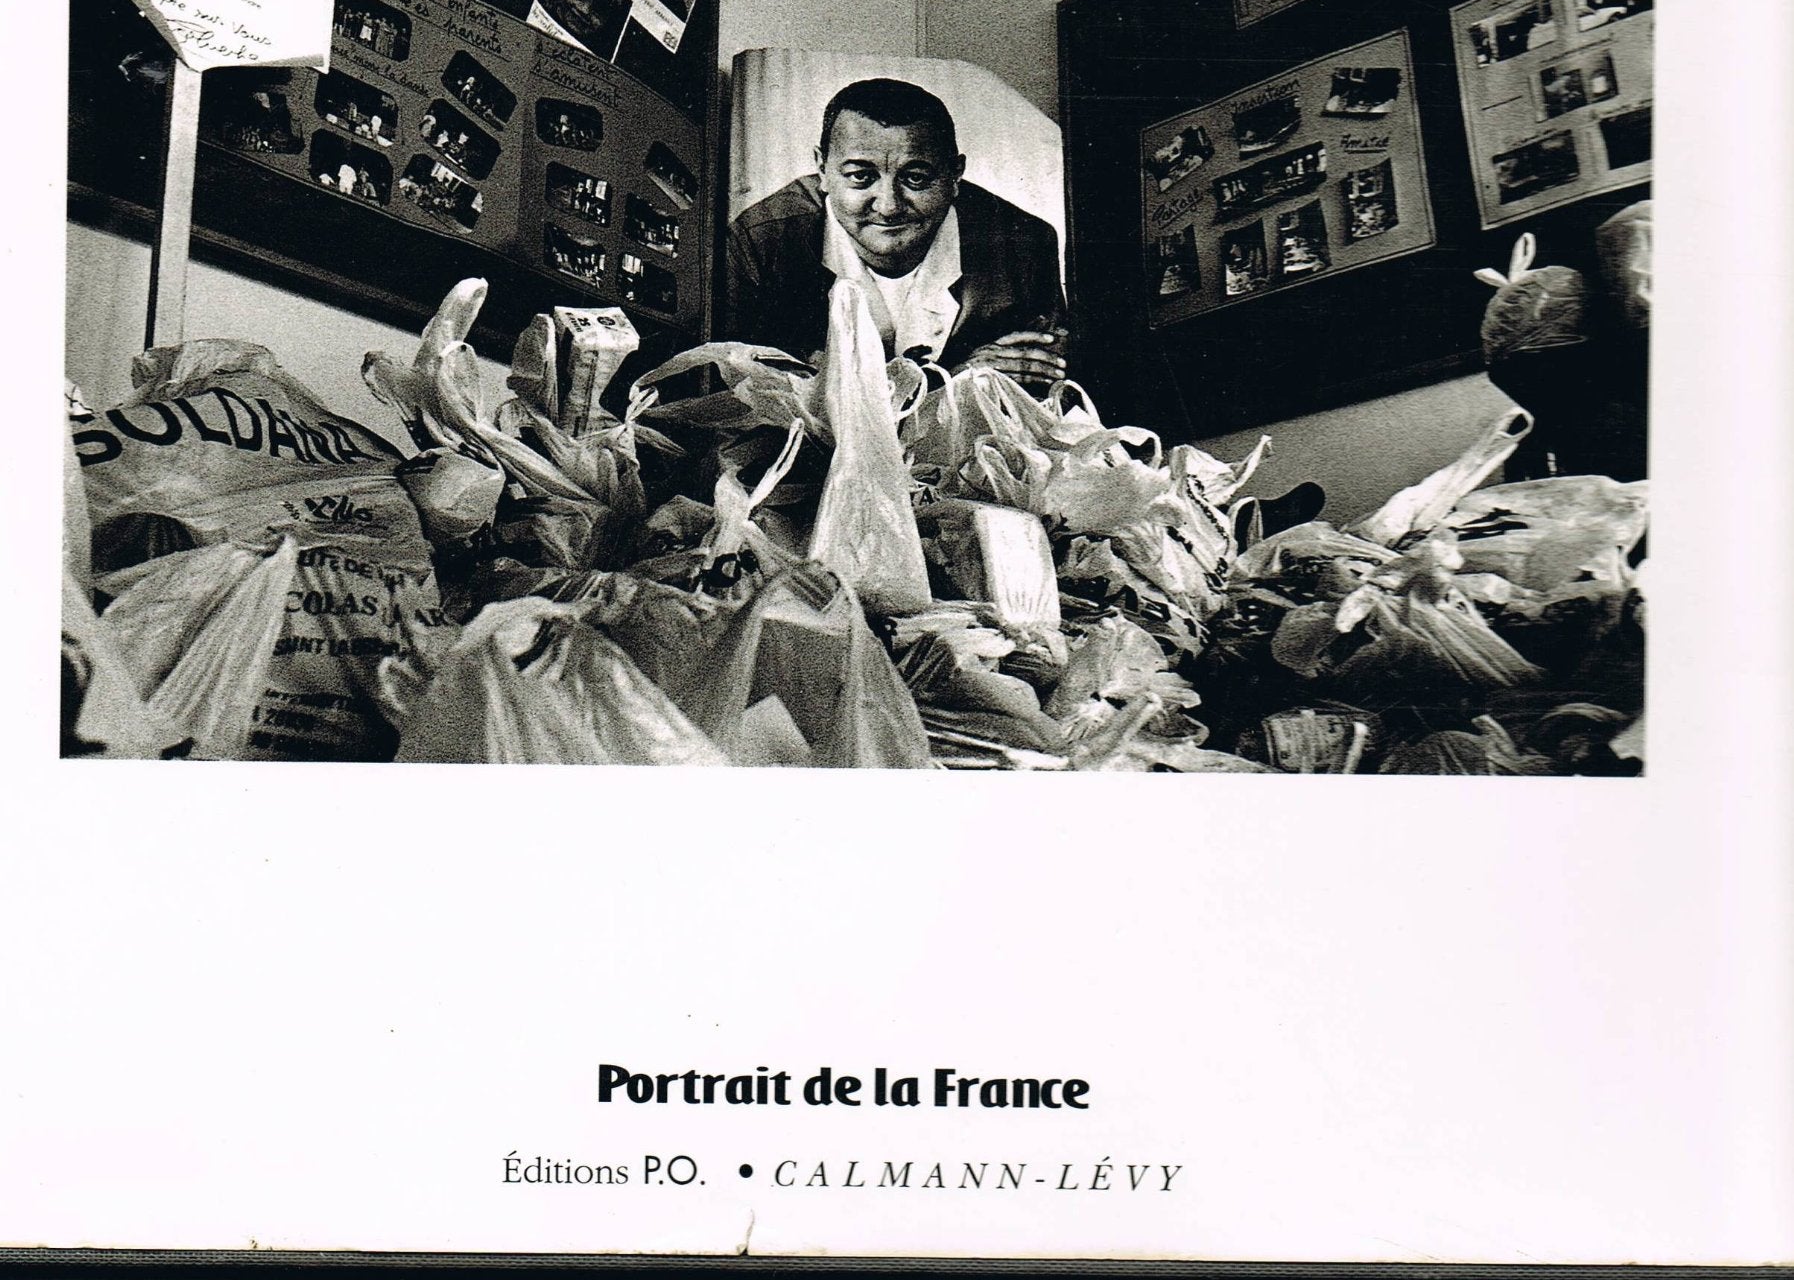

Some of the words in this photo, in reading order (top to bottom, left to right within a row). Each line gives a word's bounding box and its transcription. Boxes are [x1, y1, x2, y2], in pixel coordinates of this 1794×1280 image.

[599, 1064, 791, 1105] Portrait
[804, 1067, 861, 1106] de
[875, 1068, 920, 1106] la
[934, 1069, 1089, 1109] France
[502, 1151, 629, 1184] Éditions
[645, 1155, 705, 1185] P.O.
[773, 1156, 1183, 1191] CALMANN-LÉVY
